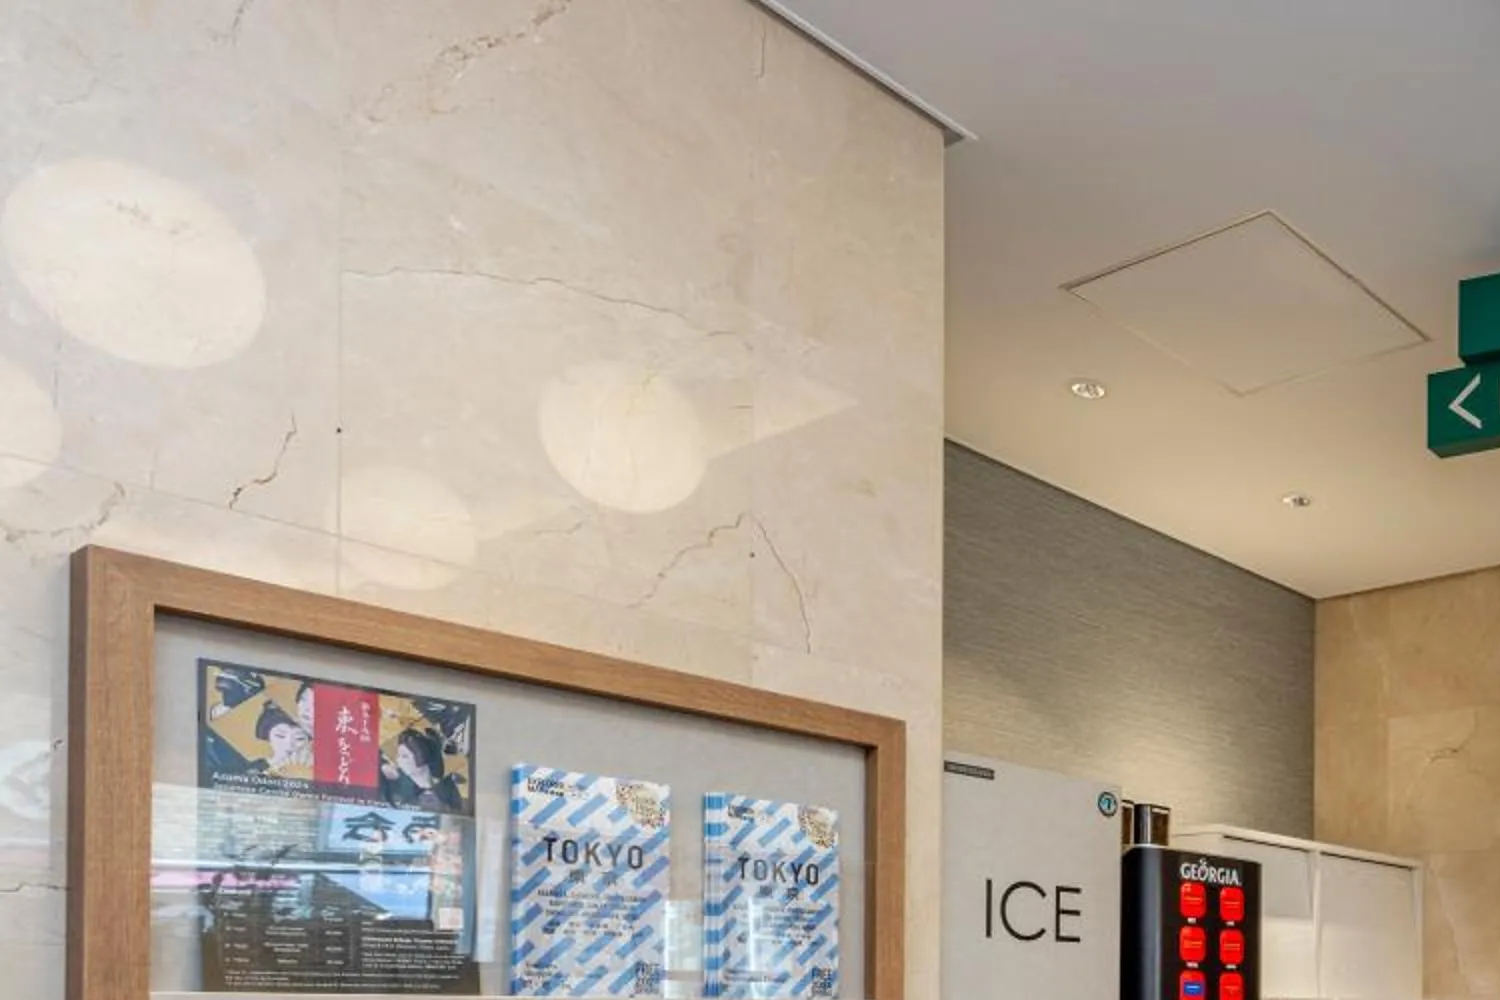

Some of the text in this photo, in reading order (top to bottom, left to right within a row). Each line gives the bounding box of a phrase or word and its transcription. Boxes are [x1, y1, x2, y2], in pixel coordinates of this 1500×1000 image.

[543, 835, 644, 870] TOKYO
[737, 856, 820, 886] TOKYO
[1180, 859, 1242, 886] GEORGIA
[984, 878, 1082, 943] ICE
